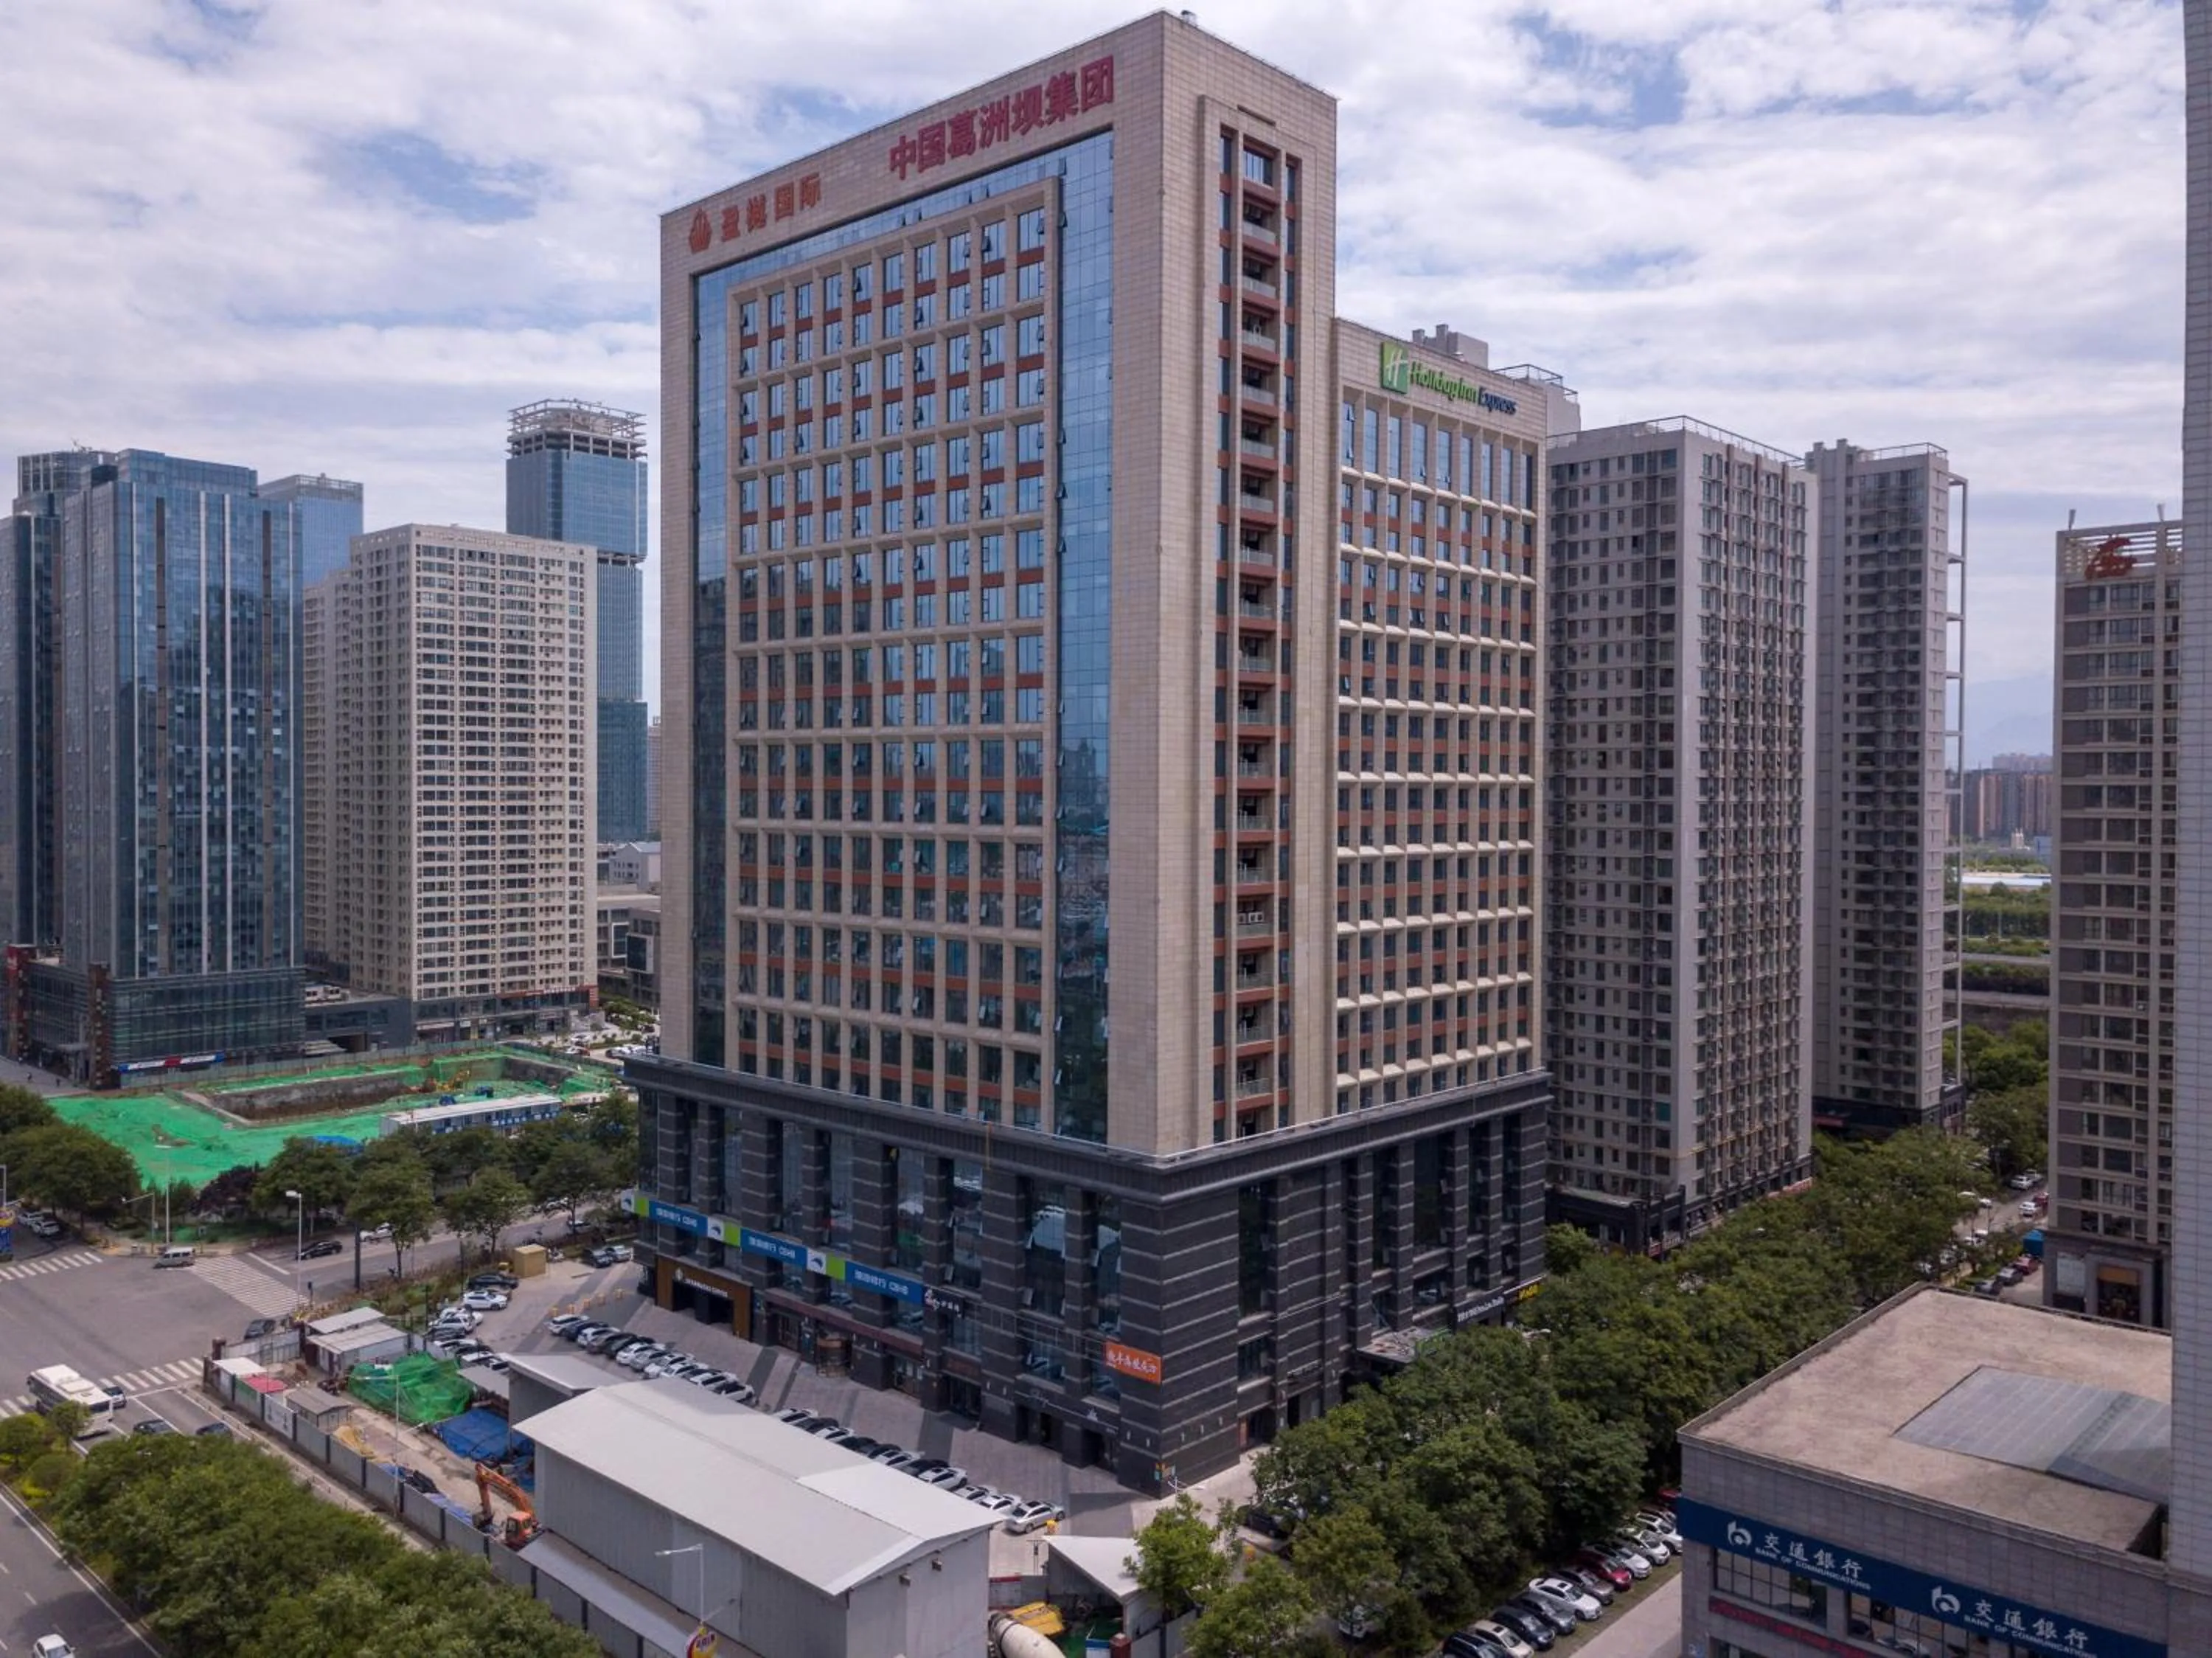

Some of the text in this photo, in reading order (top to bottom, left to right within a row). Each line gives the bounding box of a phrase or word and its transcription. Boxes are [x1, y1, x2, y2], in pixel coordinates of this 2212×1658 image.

[890, 55, 1114, 181] 中国葛洲坝集团
[1410, 361, 1517, 415] Holiday Inn Express
[1755, 1547, 1778, 1561] BANK
[1781, 1555, 1792, 1564] OF
[1964, 1614, 1990, 1628] BANK
[1994, 1625, 2008, 1633] OF
